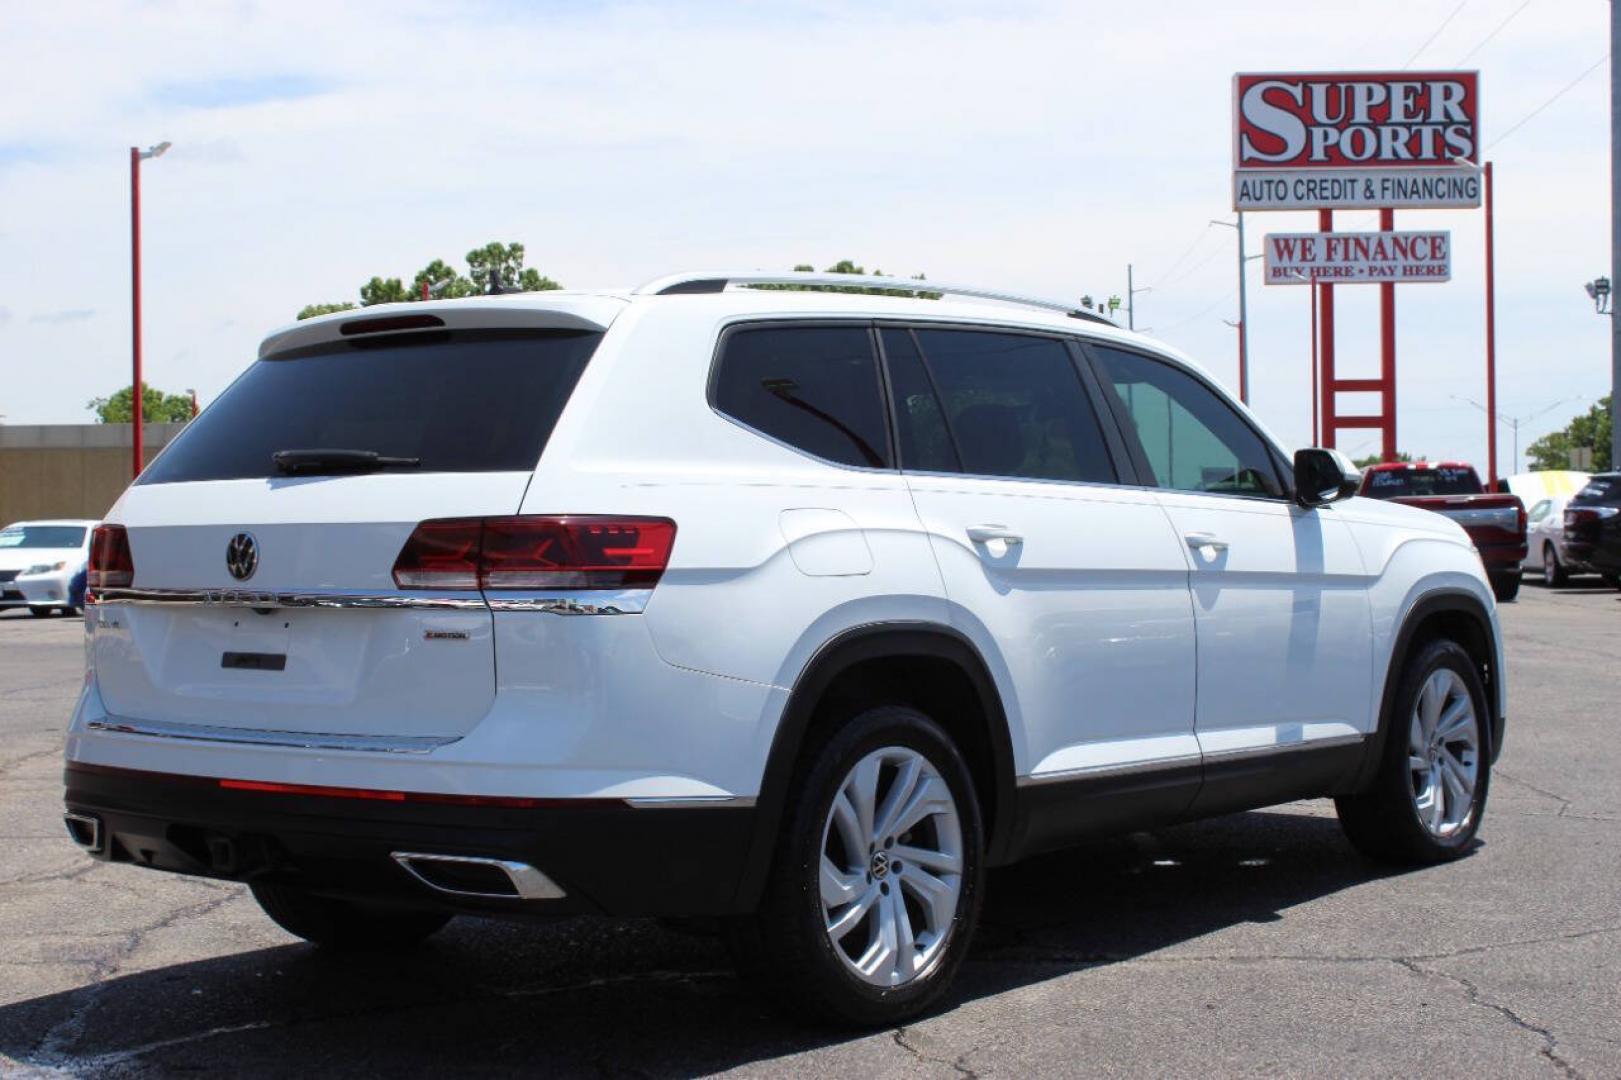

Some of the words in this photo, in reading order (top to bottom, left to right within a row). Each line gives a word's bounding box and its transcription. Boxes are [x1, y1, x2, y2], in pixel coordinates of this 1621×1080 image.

[1241, 80, 1470, 162] SUPER
[1239, 178, 1288, 202] AUTO
[1293, 178, 1358, 201] CREDIT
[1364, 179, 1376, 200] &
[1381, 176, 1478, 200] FINANCING
[1272, 236, 1317, 263] WE
[1325, 235, 1447, 262] FINANCE
[1271, 265, 1306, 278] BUY
[1310, 265, 1355, 278] HERE
[1368, 265, 1399, 277] PAY
[1402, 264, 1448, 277] HERE
